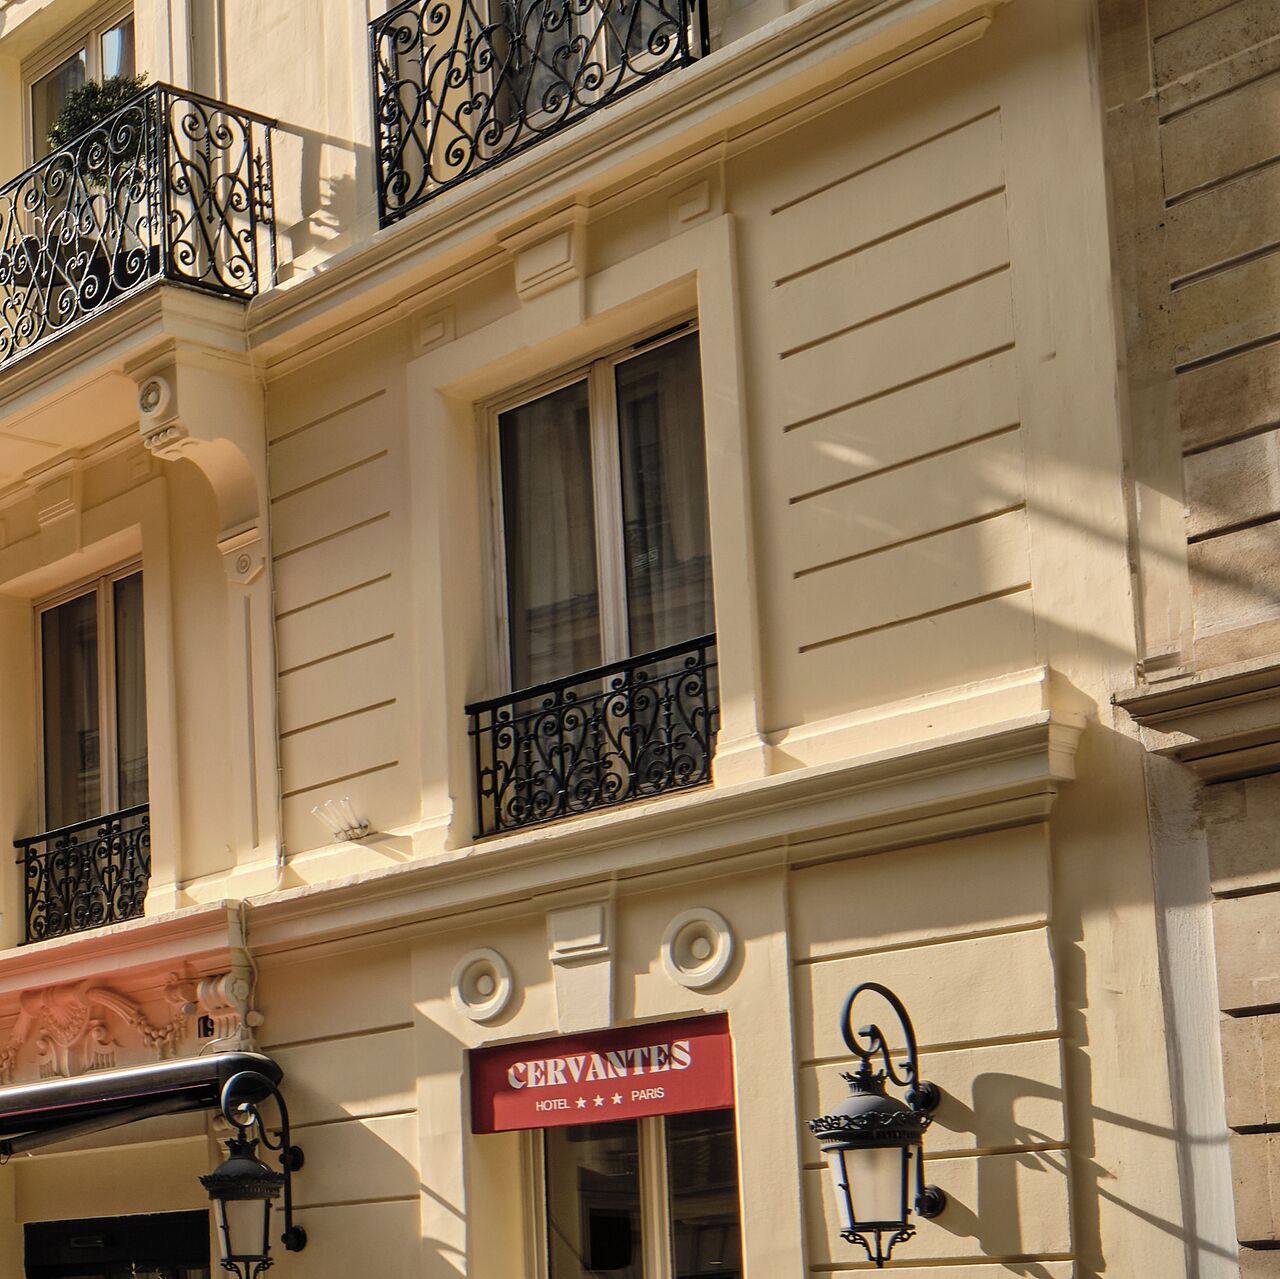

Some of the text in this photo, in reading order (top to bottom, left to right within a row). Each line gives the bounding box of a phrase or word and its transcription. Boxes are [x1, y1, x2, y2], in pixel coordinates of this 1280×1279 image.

[507, 1040, 692, 1089] CERVANTES
[536, 1086, 665, 1112] HOTEL PARIS
